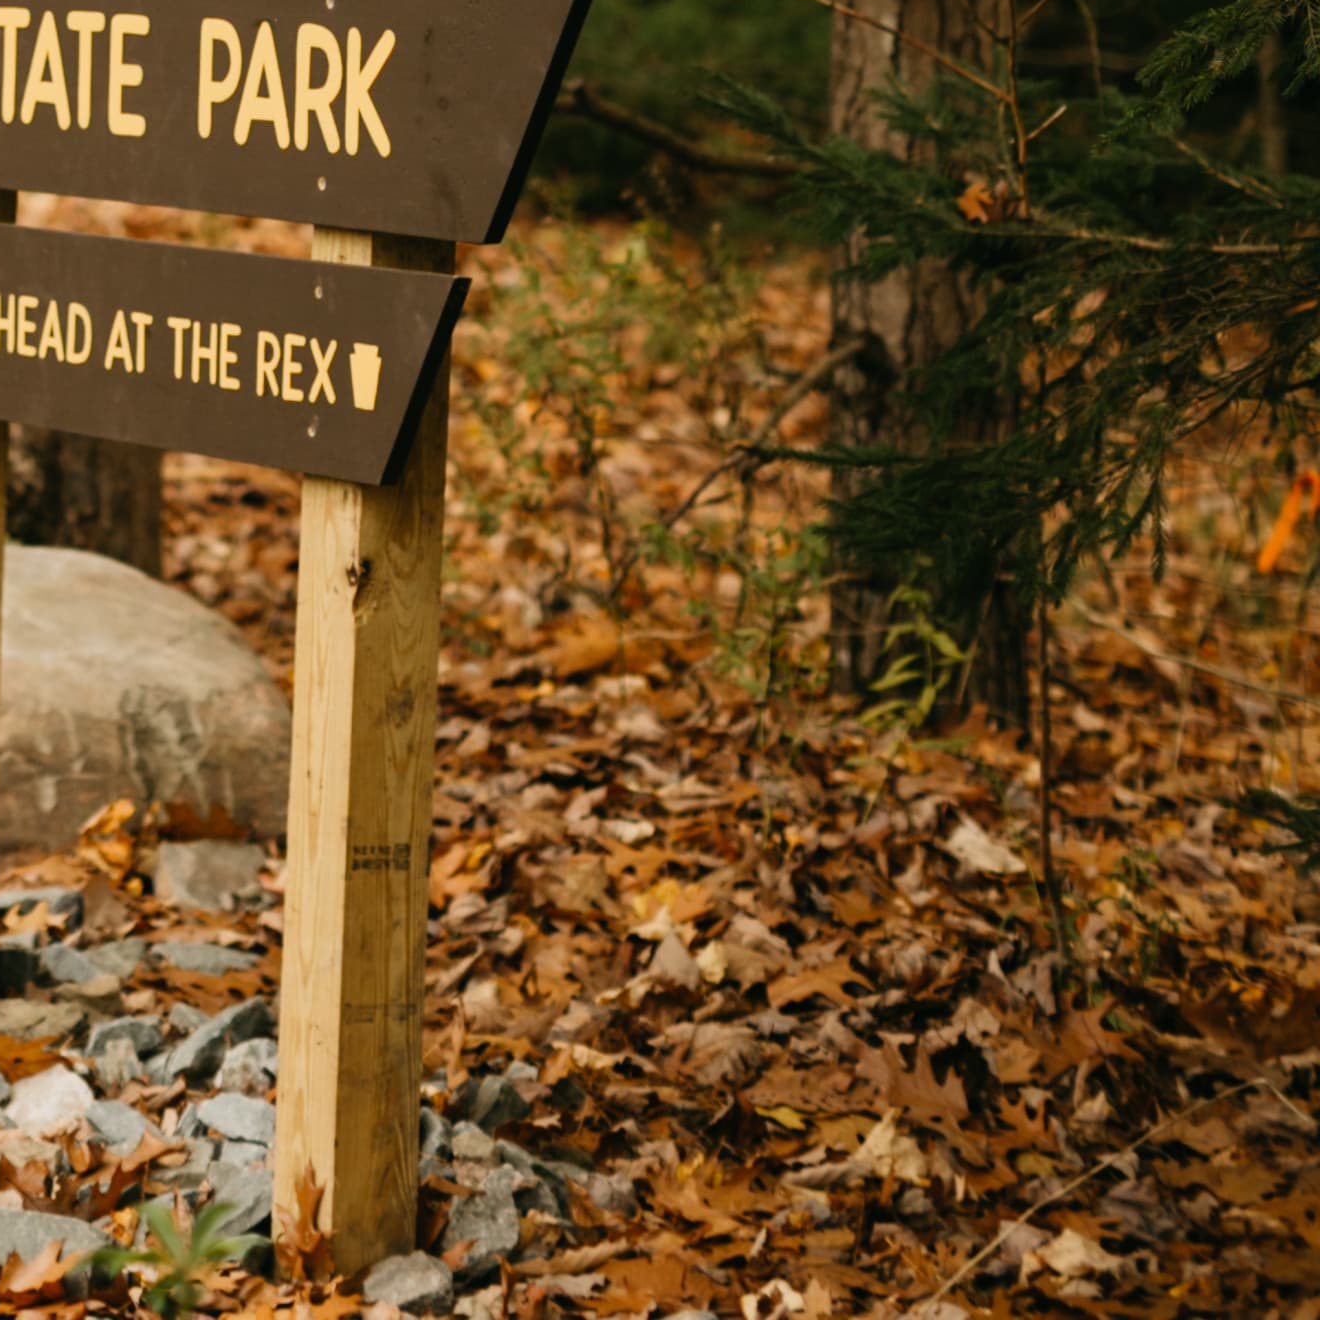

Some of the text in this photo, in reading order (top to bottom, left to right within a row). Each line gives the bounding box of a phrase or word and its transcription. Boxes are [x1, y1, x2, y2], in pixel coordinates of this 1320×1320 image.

[197, 17, 397, 158] PARK
[104, 309, 154, 374] AT
[166, 316, 243, 391] THE
[255, 330, 338, 405] REX
